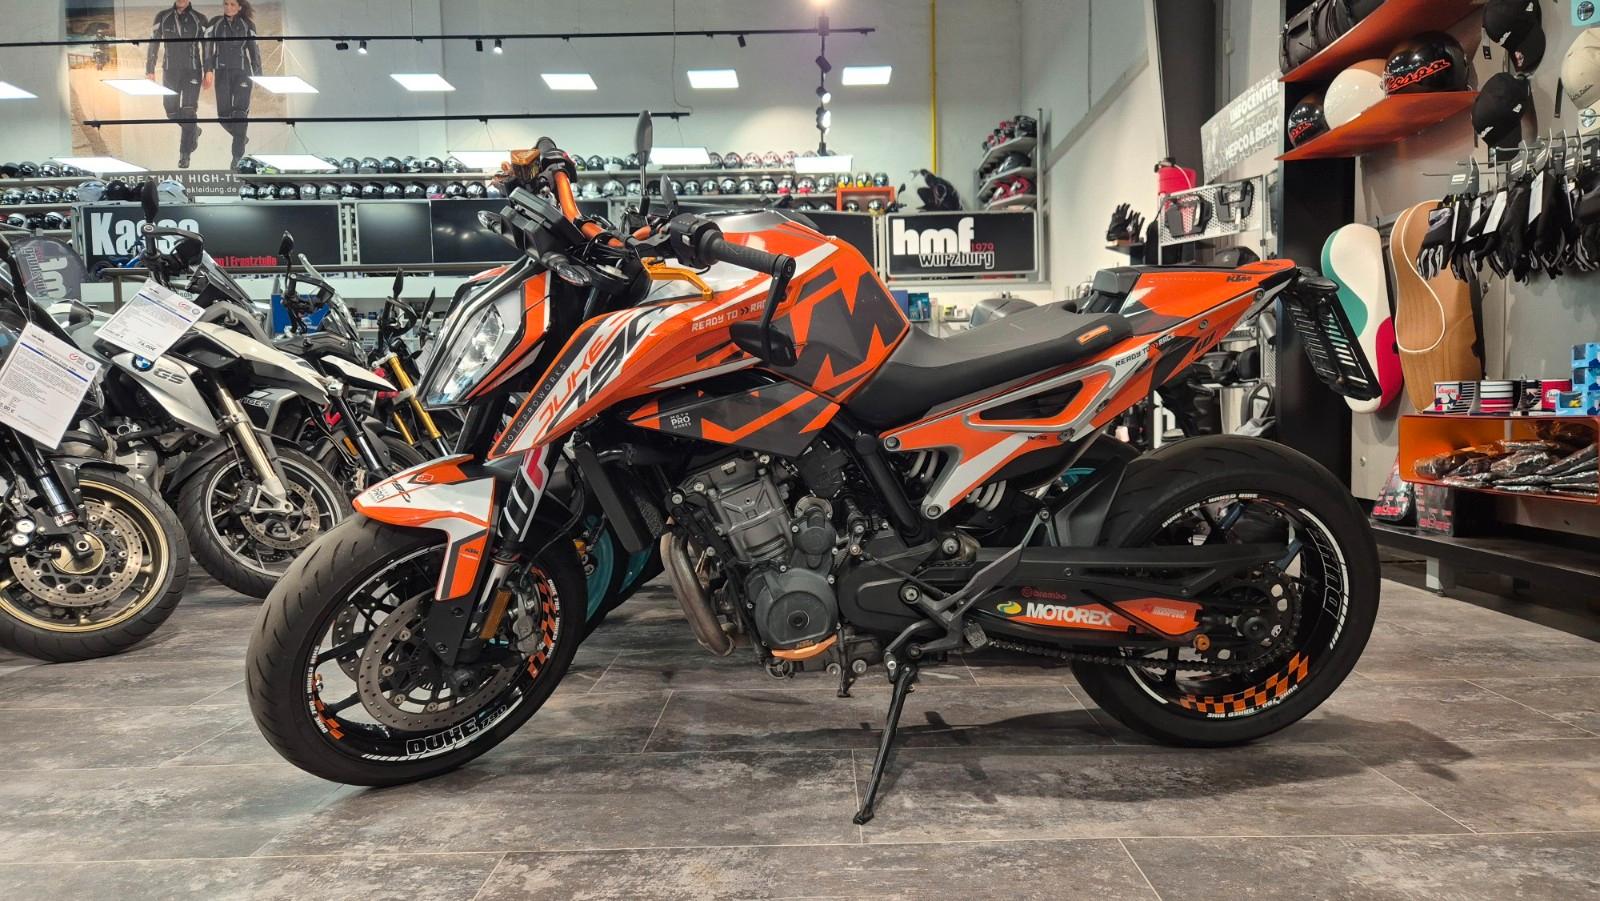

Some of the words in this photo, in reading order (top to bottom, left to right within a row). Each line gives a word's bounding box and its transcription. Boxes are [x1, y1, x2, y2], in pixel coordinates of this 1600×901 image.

[892, 217, 975, 256] hmf
[971, 243, 994, 253] 1979
[691, 314, 724, 331] READY
[726, 309, 739, 321] TO
[153, 367, 188, 385] GS
[533, 308, 634, 444] DUKE
[670, 415, 691, 426] PRO
[1026, 601, 1113, 627] MOTOREX
[406, 716, 481, 756] DUKE
